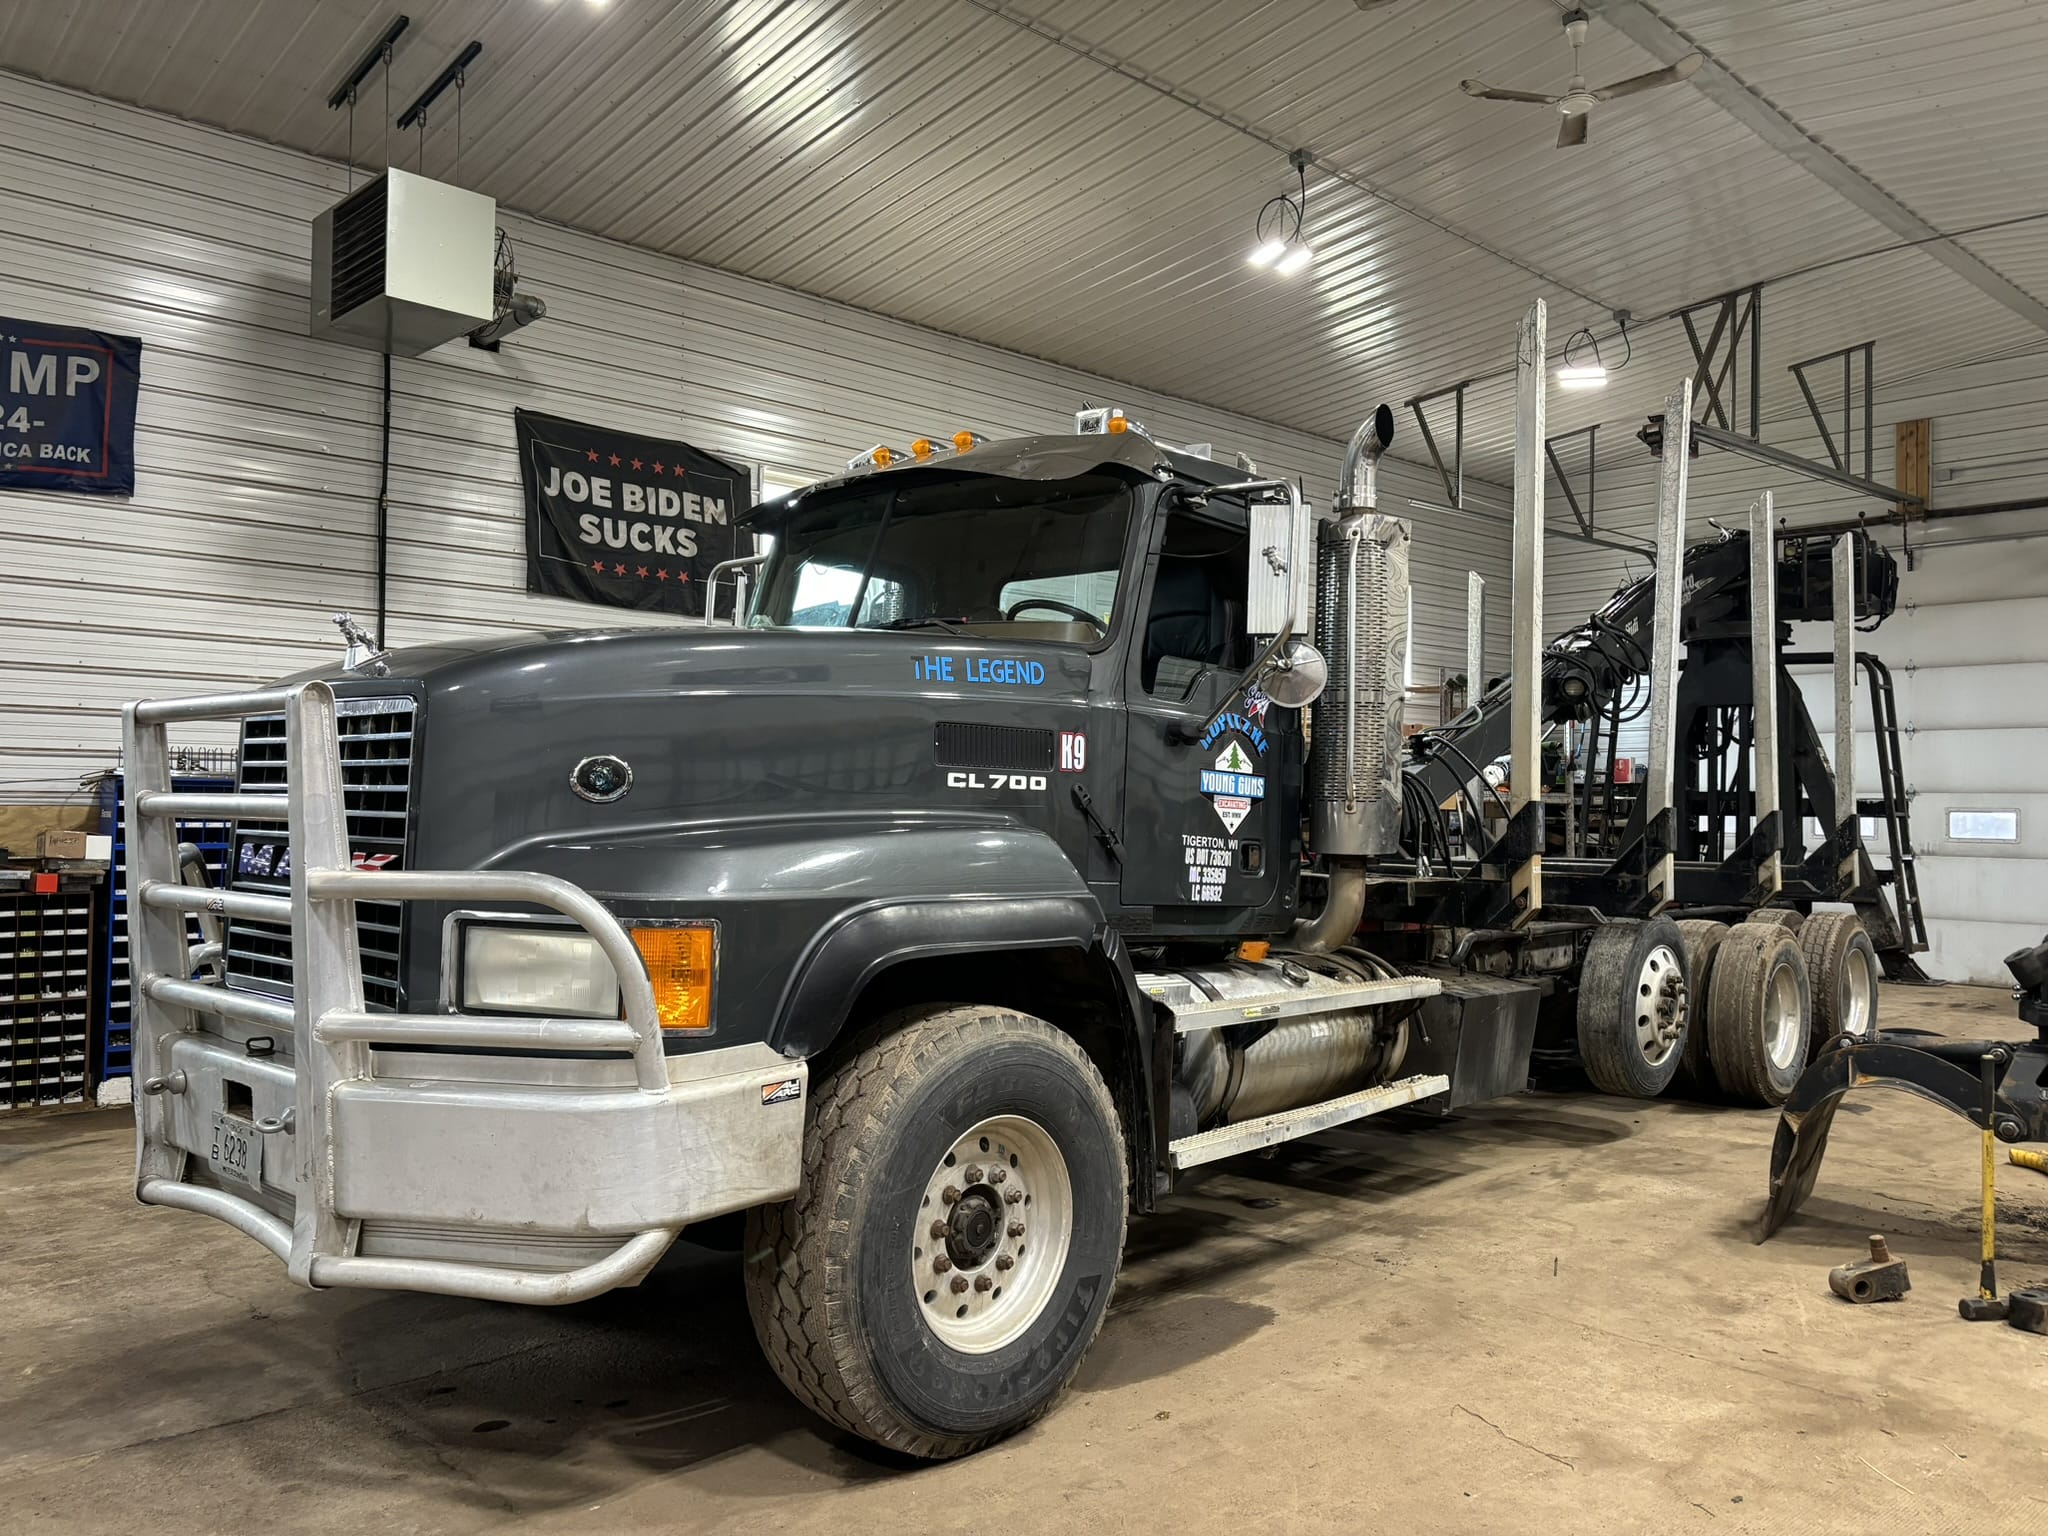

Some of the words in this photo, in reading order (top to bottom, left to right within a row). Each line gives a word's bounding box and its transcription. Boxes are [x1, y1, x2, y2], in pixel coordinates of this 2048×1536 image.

[0, 405, 45, 433] 4-
[40, 443, 91, 463] BACK
[544, 466, 613, 509] JOE
[622, 482, 727, 526] BIDEN
[579, 513, 698, 558] SUCKS
[911, 655, 955, 682] THE
[966, 658, 1045, 685] LEGEND
[1060, 733, 1087, 771] K9
[1202, 772, 1236, 794] YOUNG
[1238, 776, 1264, 797] GUNS
[1182, 834, 1226, 850] TIGERTON,
[1228, 839, 1239, 850] WI
[1185, 847, 1195, 864] US
[1196, 848, 1209, 865] DOT
[1189, 866, 1201, 883] MC
[1191, 884, 1201, 901] LC
[223, 1133, 247, 1170] 6238
